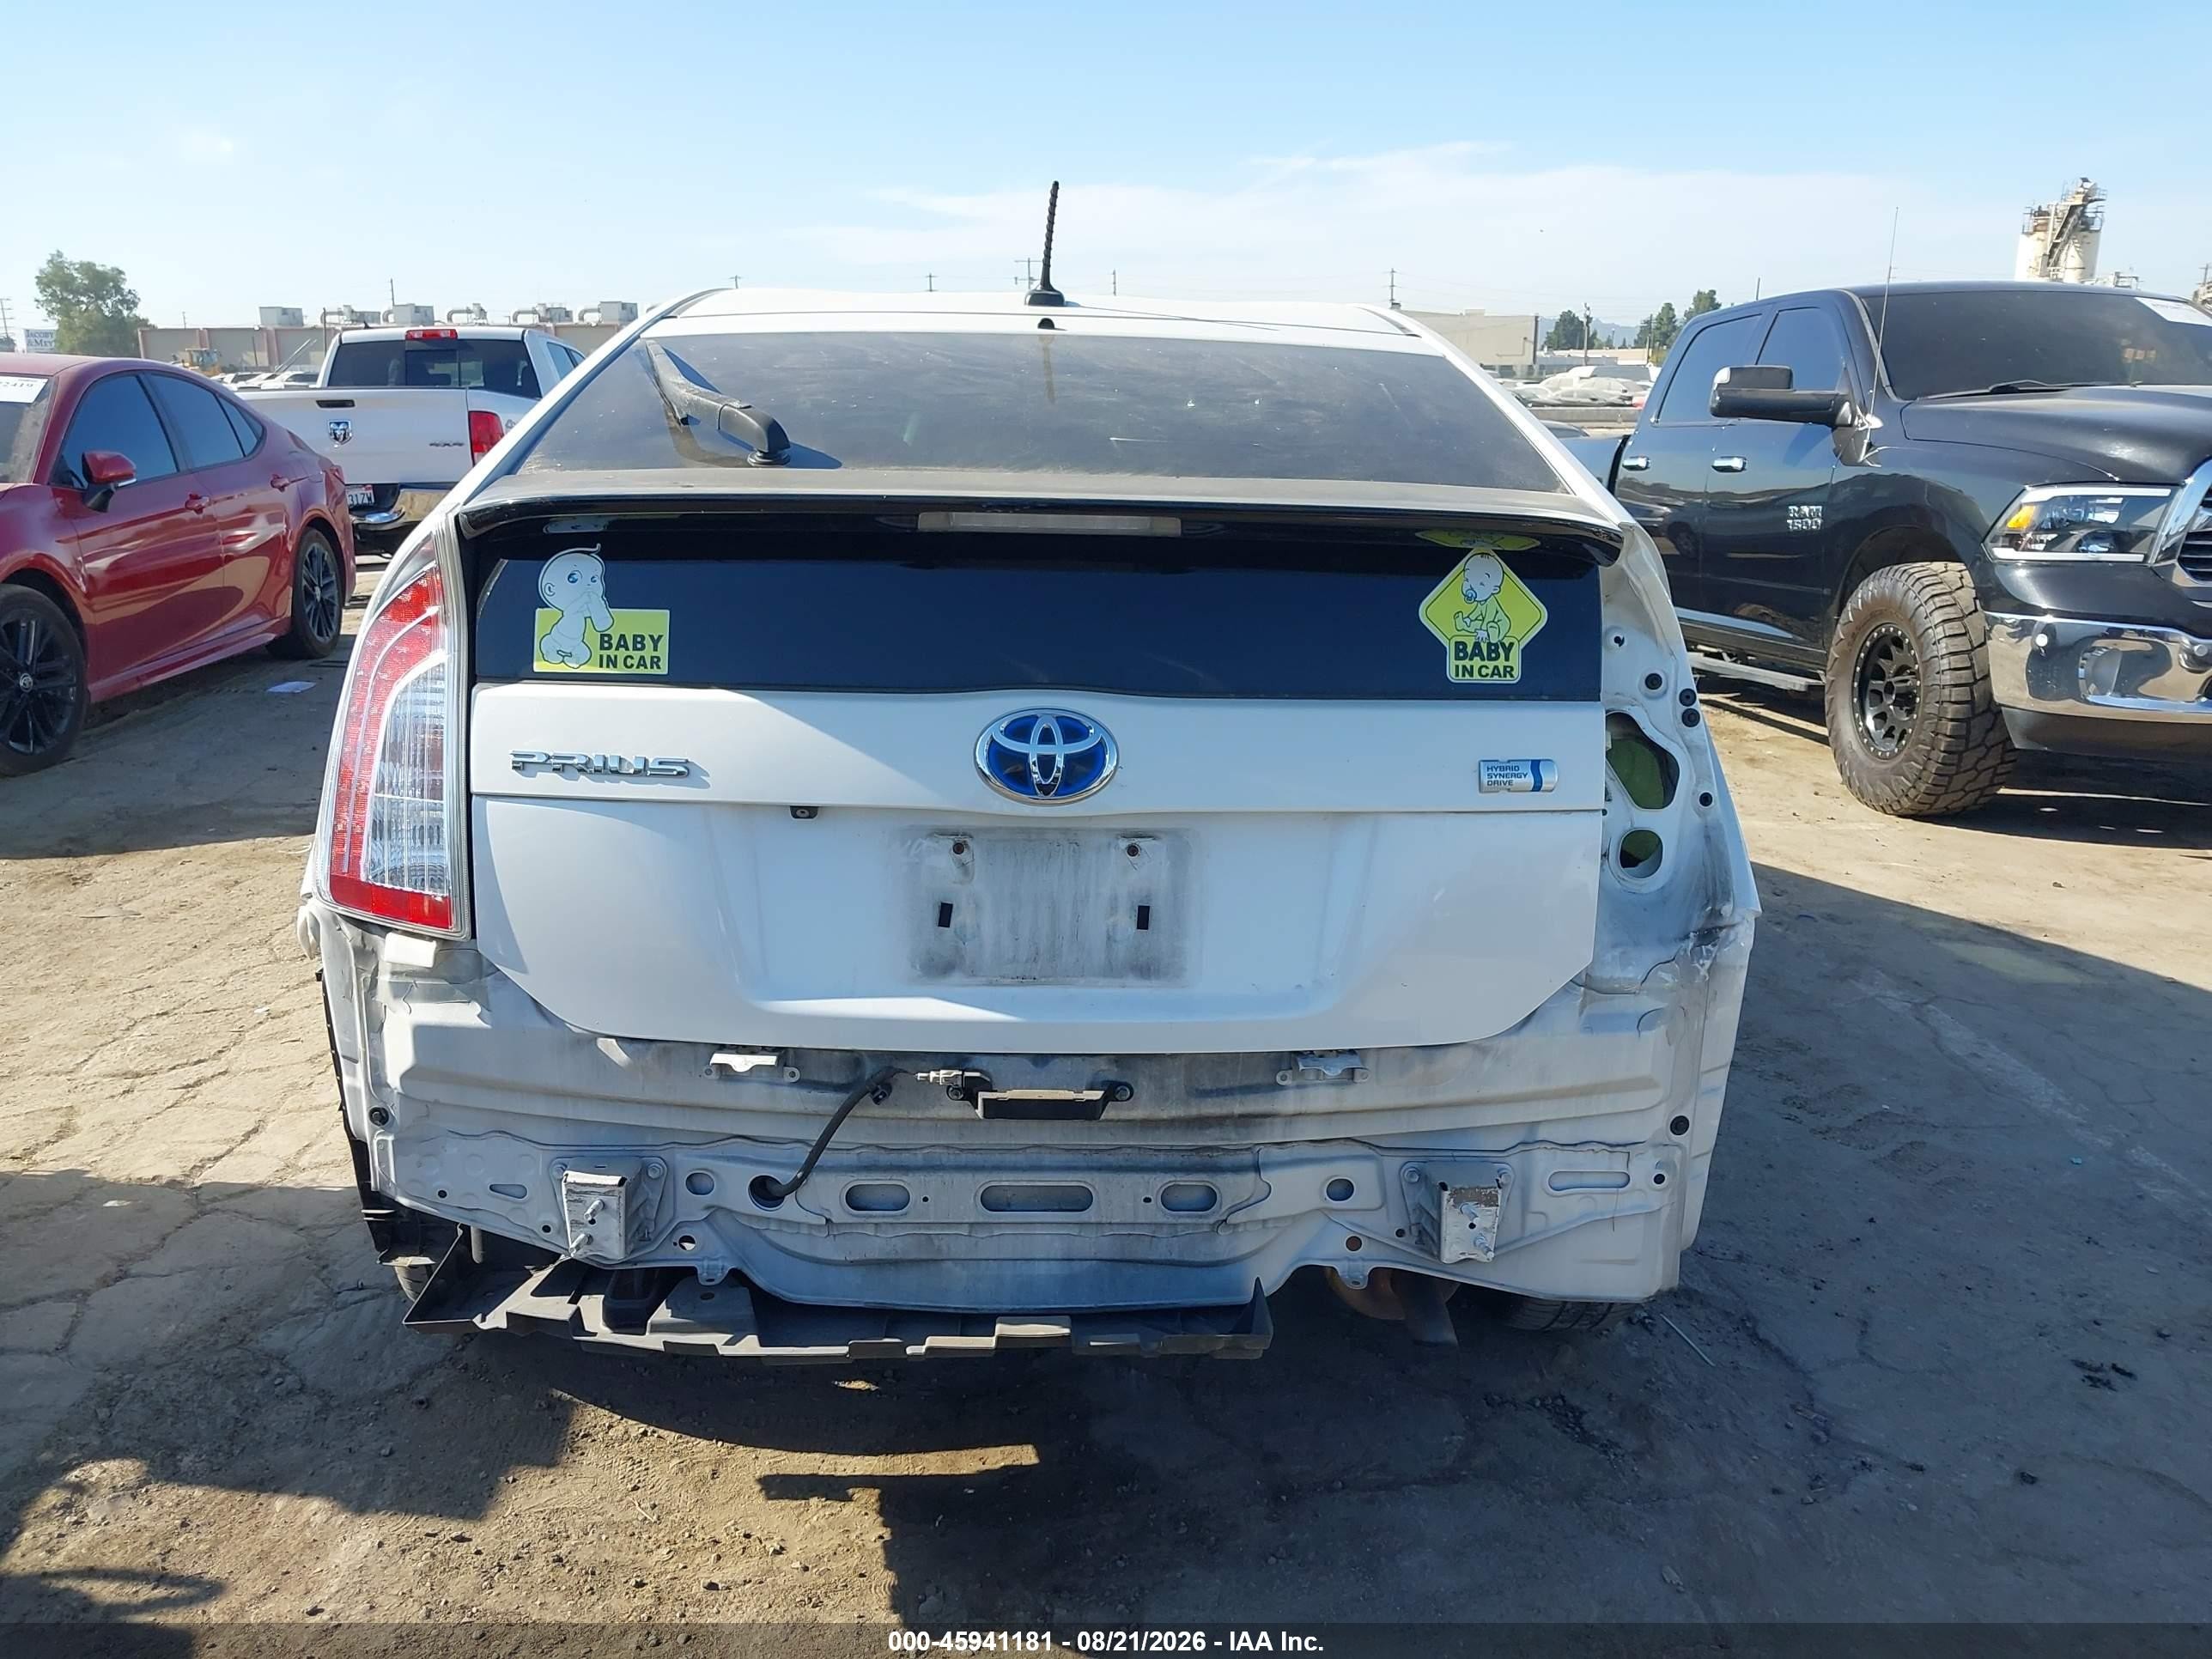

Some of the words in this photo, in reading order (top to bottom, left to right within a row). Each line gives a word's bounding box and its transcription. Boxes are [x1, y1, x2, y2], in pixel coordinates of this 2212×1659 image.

[1788, 505, 1823, 518] RAM
[1786, 518, 1822, 531] 1500
[599, 633, 665, 652] BABY
[1453, 641, 1515, 662] BABY
[599, 654, 618, 669] IN
[623, 654, 662, 670] CAR
[1455, 665, 1474, 678] IN
[1477, 665, 1515, 678] CAR
[509, 750, 690, 776] PRIUS
